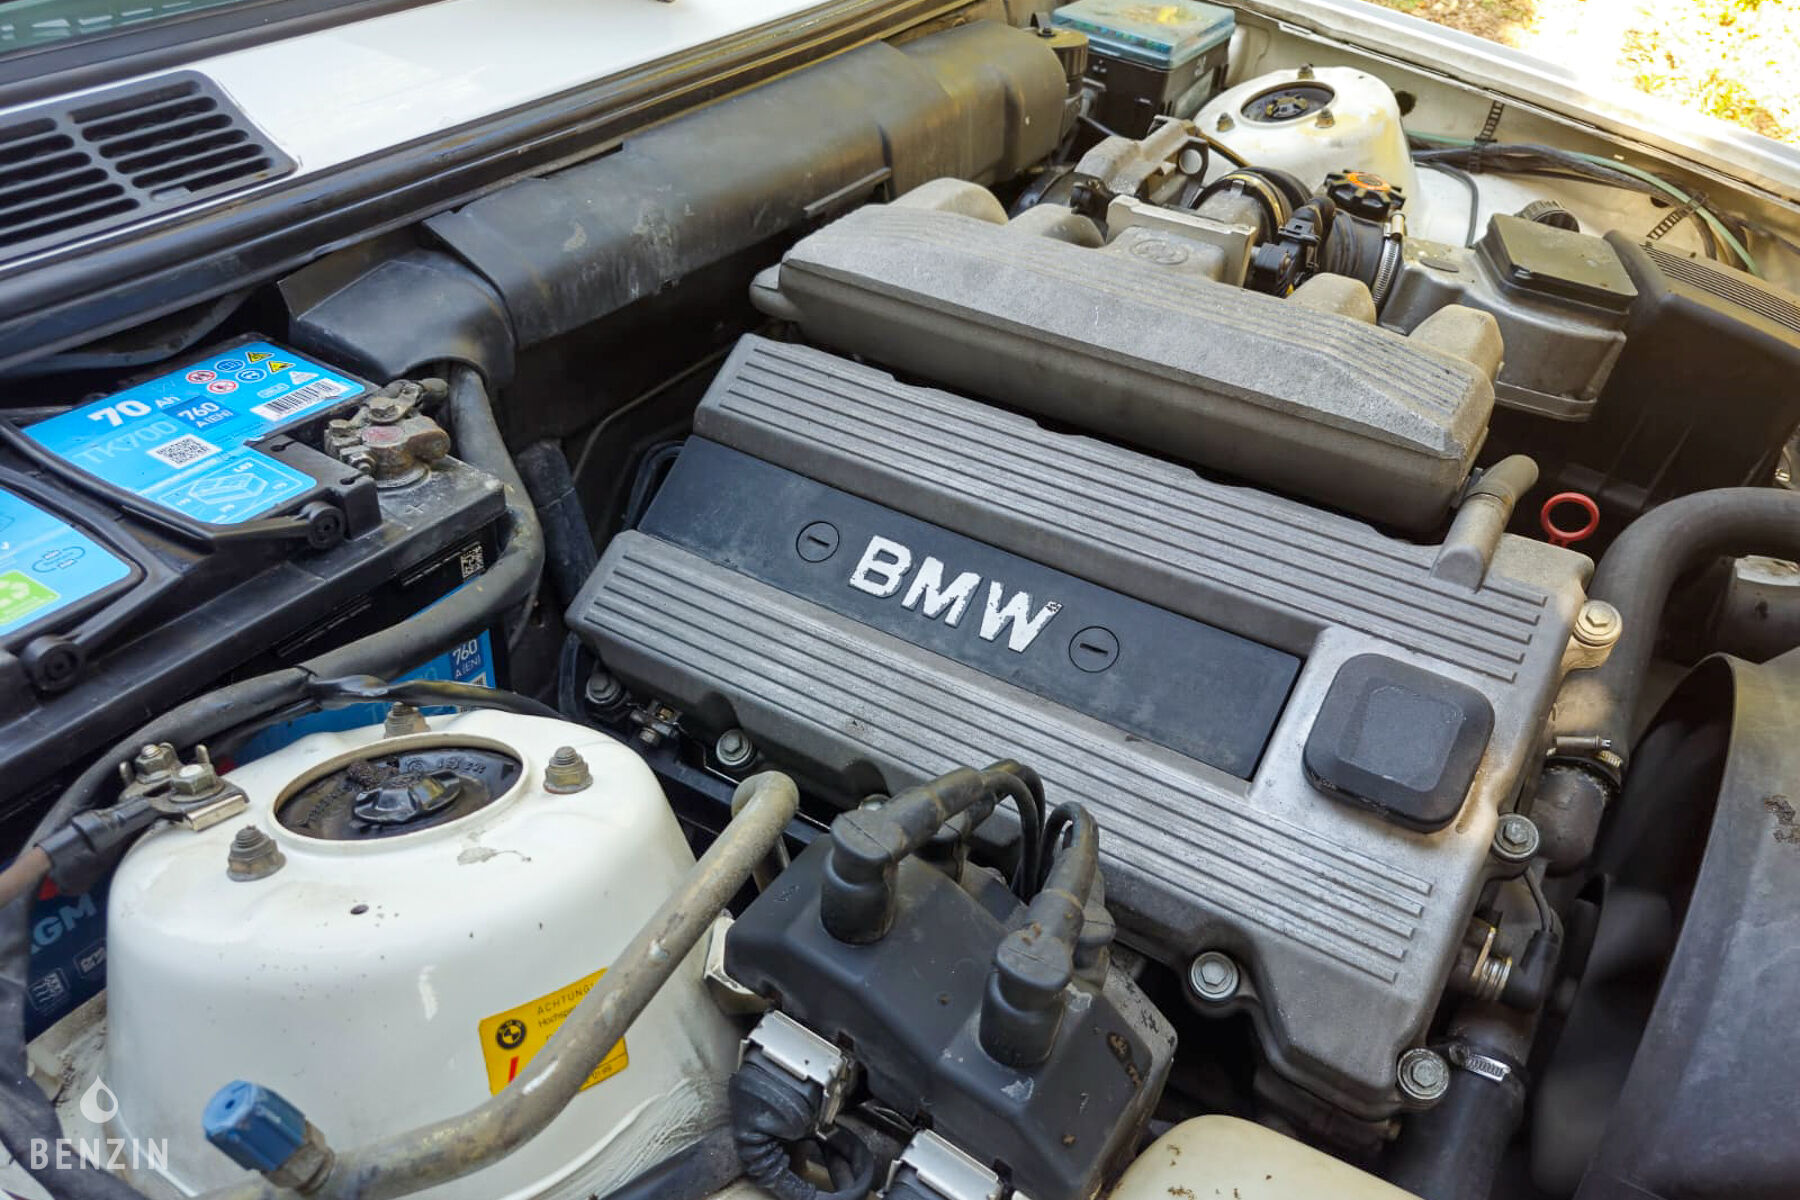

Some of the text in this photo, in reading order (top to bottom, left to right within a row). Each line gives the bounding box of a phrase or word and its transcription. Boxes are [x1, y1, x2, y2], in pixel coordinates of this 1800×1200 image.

[87, 393, 182, 427] 70 Ah
[177, 402, 220, 421] 760
[74, 420, 179, 464] TK700
[849, 535, 1064, 653] BMW
[452, 639, 478, 666] 760
[31, 893, 97, 955] GM
